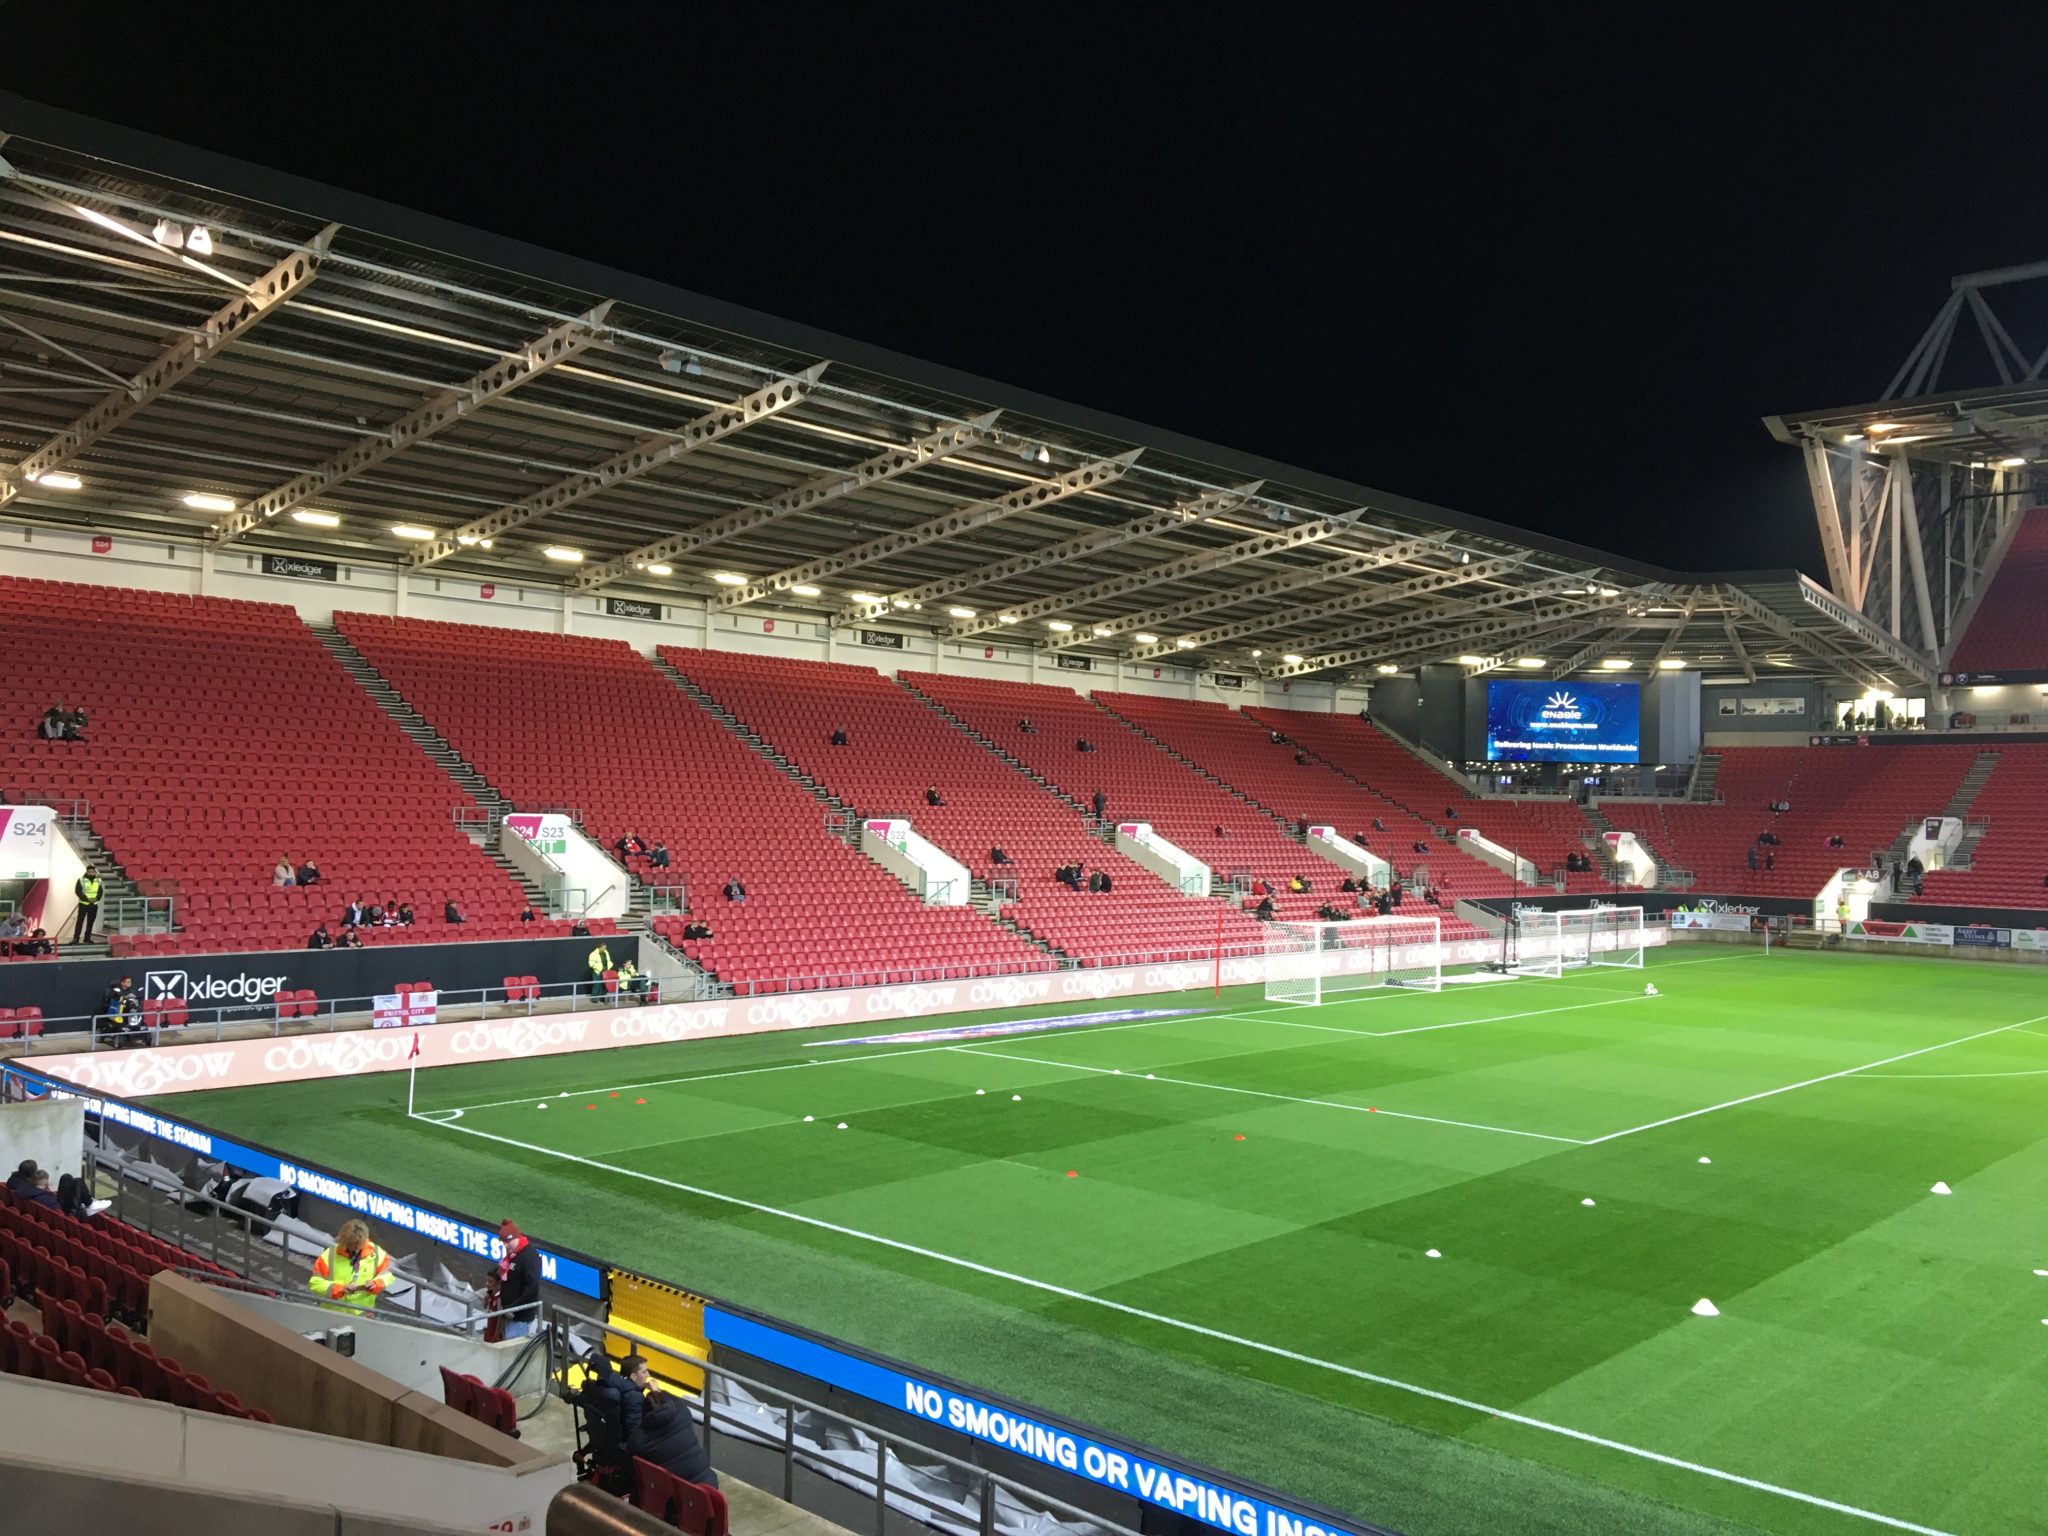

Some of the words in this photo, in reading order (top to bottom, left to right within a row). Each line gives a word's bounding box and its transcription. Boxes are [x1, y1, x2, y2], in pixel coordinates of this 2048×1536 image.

[286, 562, 323, 576] xledger
[625, 601, 651, 615] xledger
[1494, 741, 1531, 751] Delivering
[1532, 741, 1554, 750] Iconic
[1555, 742, 1597, 751] Promotions
[1598, 743, 1638, 752] Worldwide
[13, 822, 47, 836] S24
[542, 827, 564, 838] S23
[890, 831, 906, 840] S22
[1865, 870, 1880, 879] A8
[188, 972, 287, 1003] xledger
[157, 1119, 174, 1138] THE
[174, 1126, 211, 1154] STADIUM
[280, 1163, 297, 1185] NO
[297, 1170, 349, 1204] SMOKING
[350, 1188, 368, 1211] OR
[368, 1194, 414, 1229] VAPING
[415, 1210, 459, 1245] INSIDE
[460, 1226, 489, 1256] THE
[905, 1381, 943, 1420] NO
[948, 1398, 1077, 1470] SMOKING
[1083, 1446, 1129, 1488] OR
[1134, 1462, 1257, 1533] VAPING
